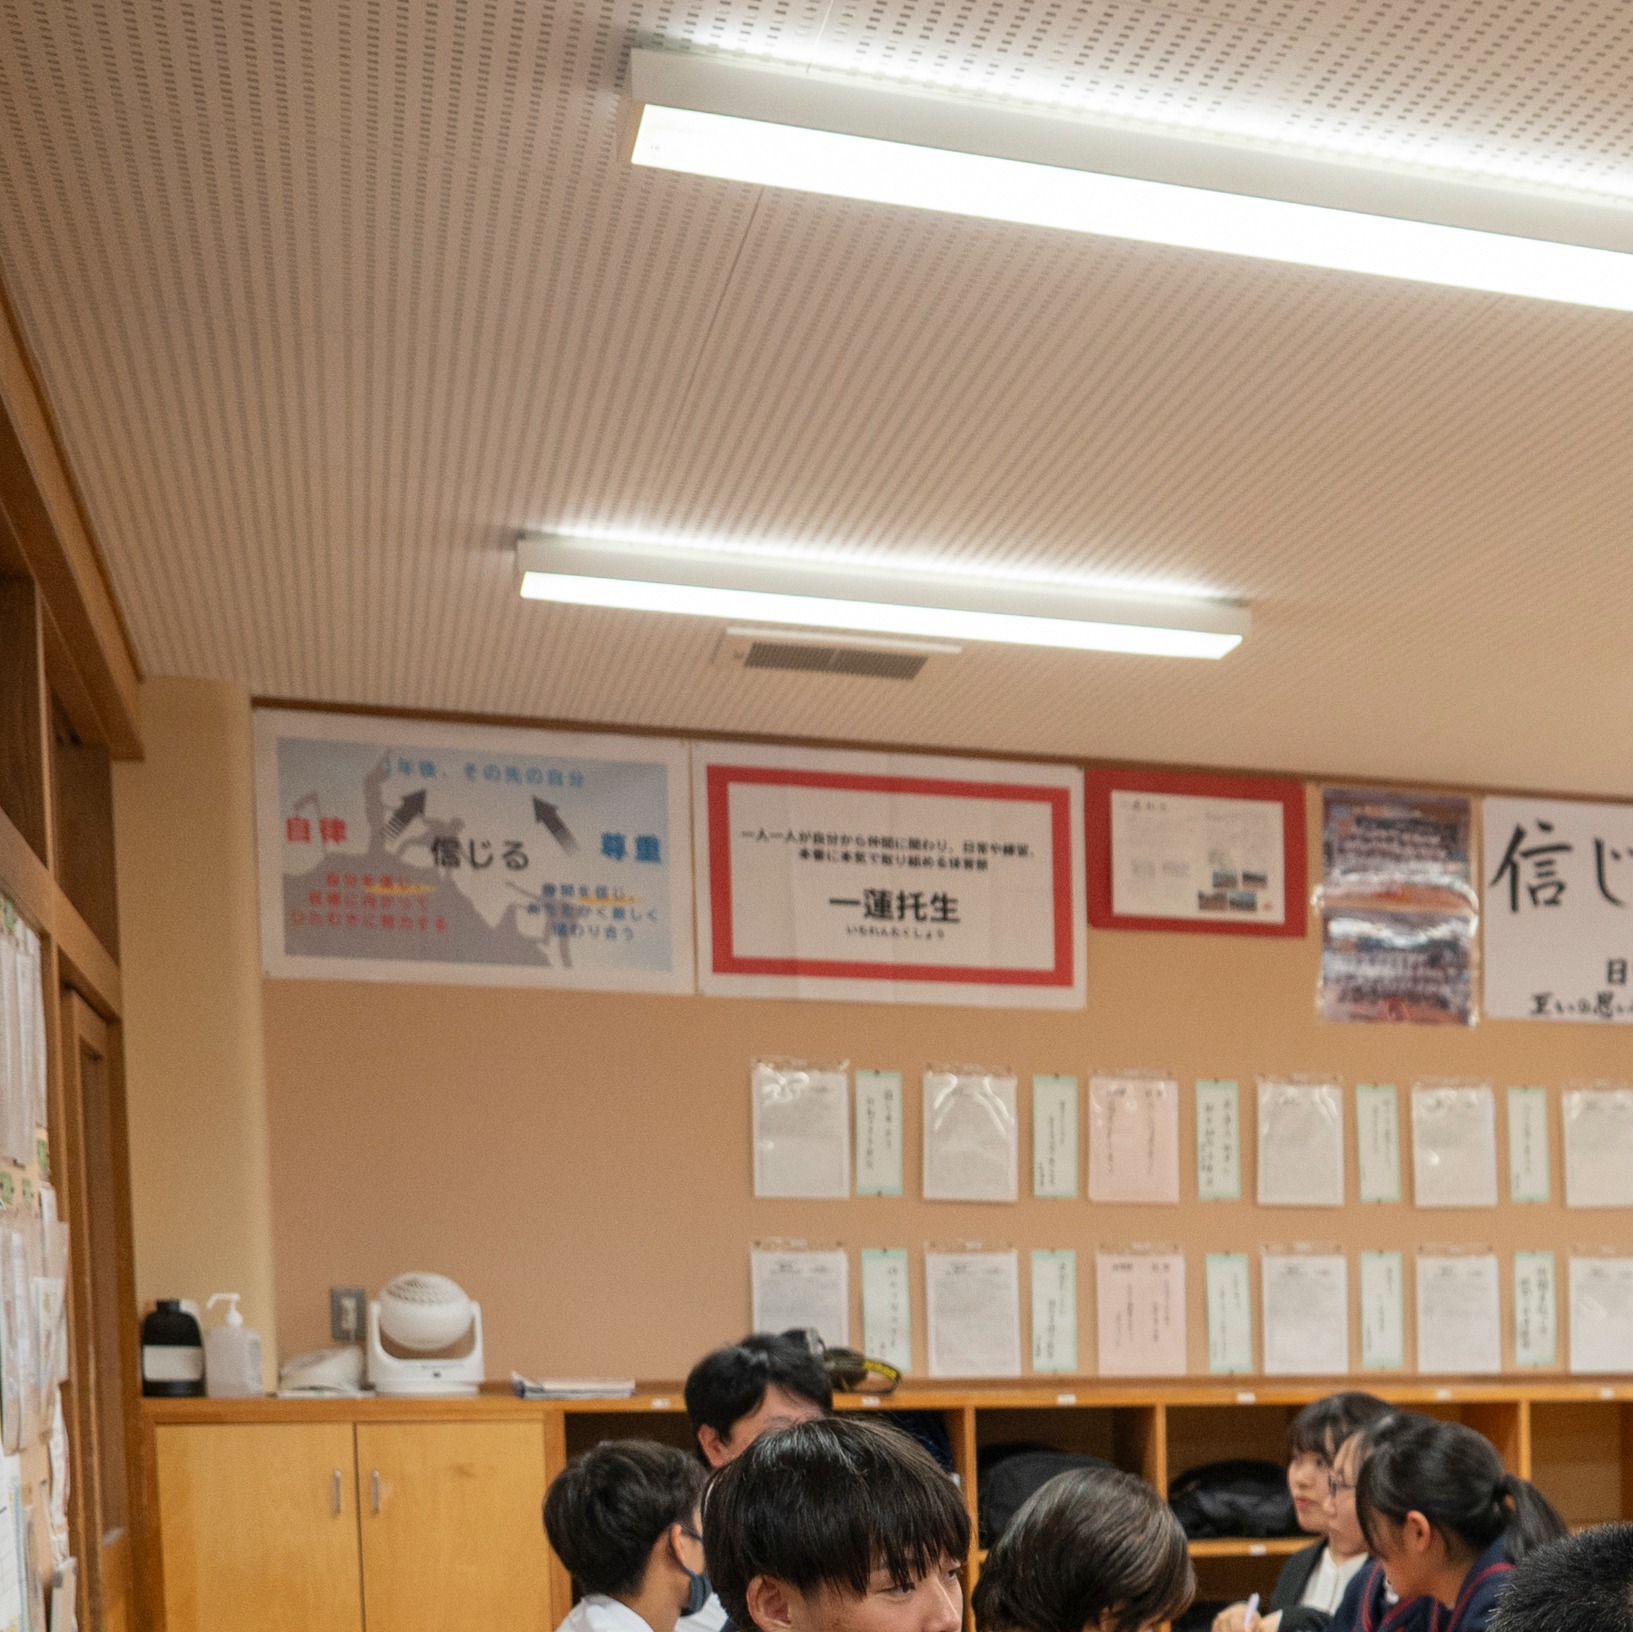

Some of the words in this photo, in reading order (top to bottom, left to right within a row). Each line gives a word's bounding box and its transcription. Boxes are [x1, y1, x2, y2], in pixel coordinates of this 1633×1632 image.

[286, 816, 348, 845] 自律
[431, 836, 530, 870] 信じる
[601, 832, 661, 863] 尊重
[829, 886, 960, 923] 一蓮托生
